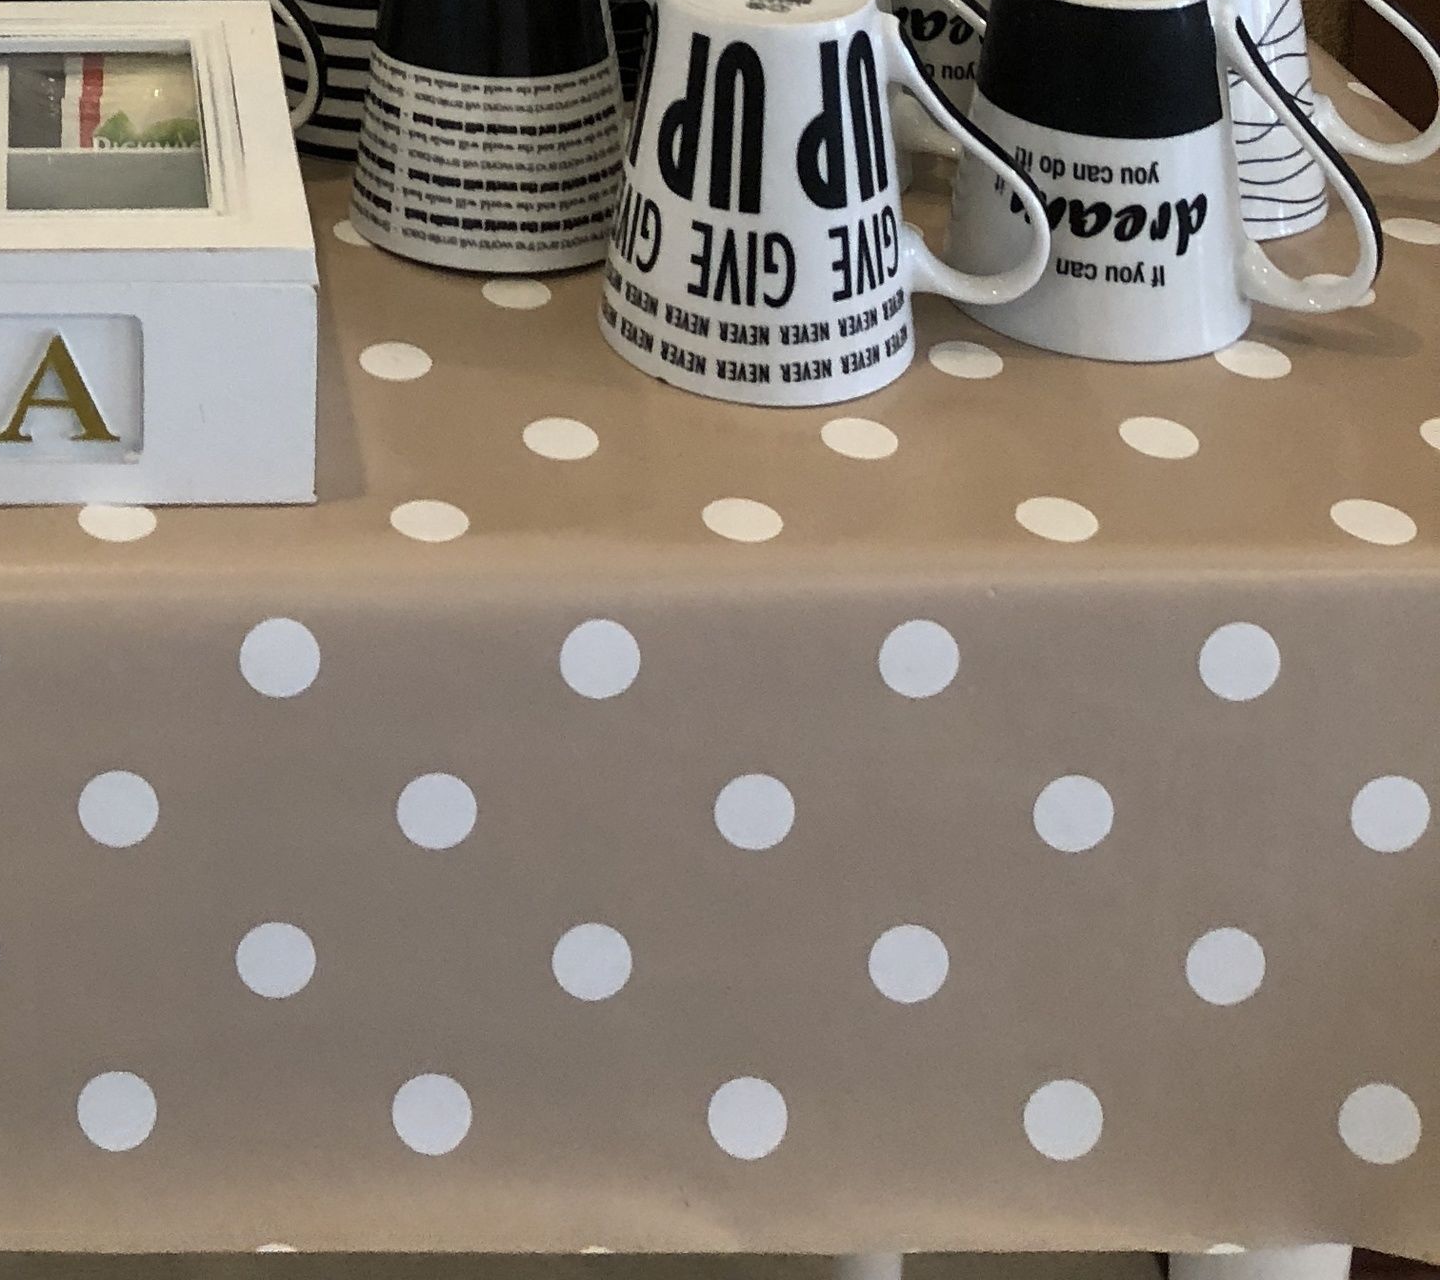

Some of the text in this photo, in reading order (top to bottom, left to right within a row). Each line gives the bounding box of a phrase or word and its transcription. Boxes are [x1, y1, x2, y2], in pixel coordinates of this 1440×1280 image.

[942, 62, 975, 80] you
[658, 32, 766, 214] UP
[797, 29, 888, 210] UP
[1040, 156, 1065, 178] do
[1073, 163, 1113, 184] can
[1121, 162, 1160, 186] you
[687, 220, 796, 308] GIVE
[828, 206, 899, 303] GIVE
[1056, 258, 1165, 287] If you can
[625, 281, 659, 317] NEVER
[665, 303, 710, 337] NEVER
[719, 320, 770, 346] NEVER
[780, 321, 830, 346] NEVER
[838, 308, 878, 337] NEVER
[621, 317, 654, 354] NEVER
[660, 341, 707, 375] NEVER
[716, 359, 770, 383] NEVER
[780, 358, 832, 383] NEVER
[840, 344, 880, 374] NEVER
